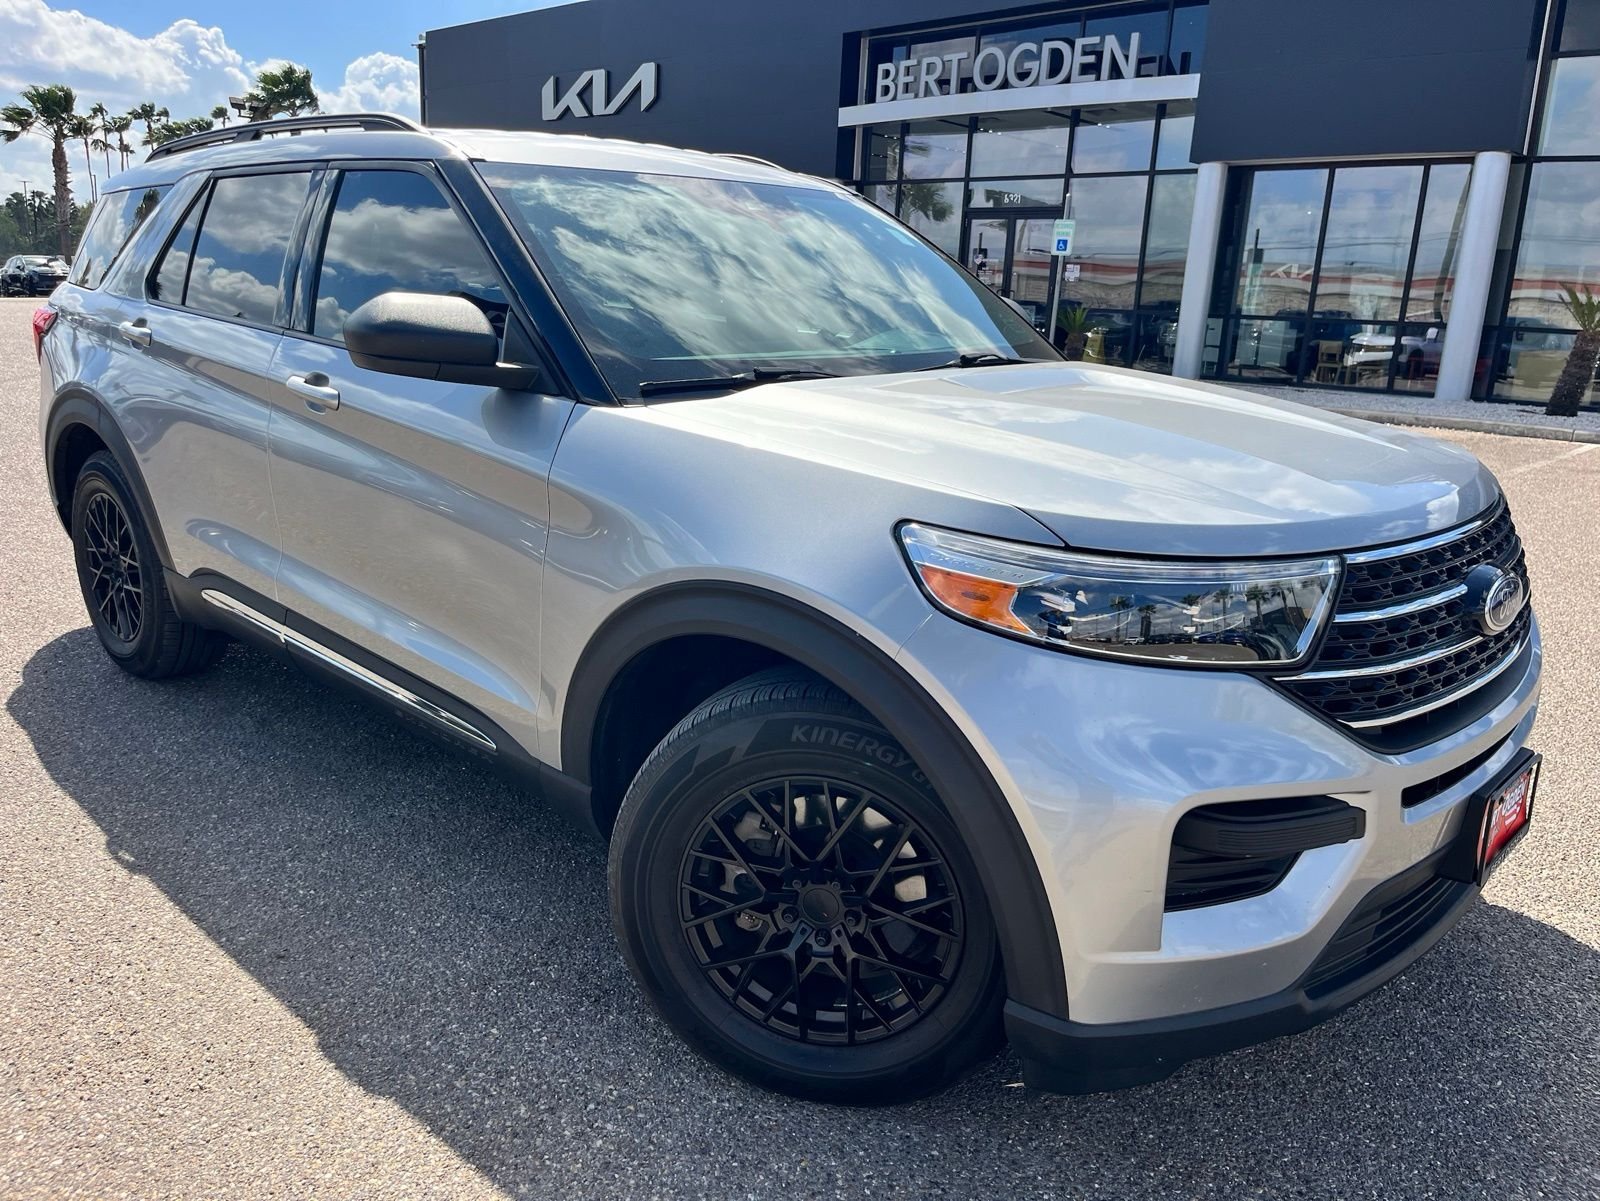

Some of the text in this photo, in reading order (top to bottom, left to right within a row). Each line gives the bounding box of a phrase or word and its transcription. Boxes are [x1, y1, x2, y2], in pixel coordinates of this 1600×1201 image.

[541, 62, 658, 121] KIA
[876, 32, 1140, 103] BERT OGDEN
[790, 724, 933, 790] KINERGY G
